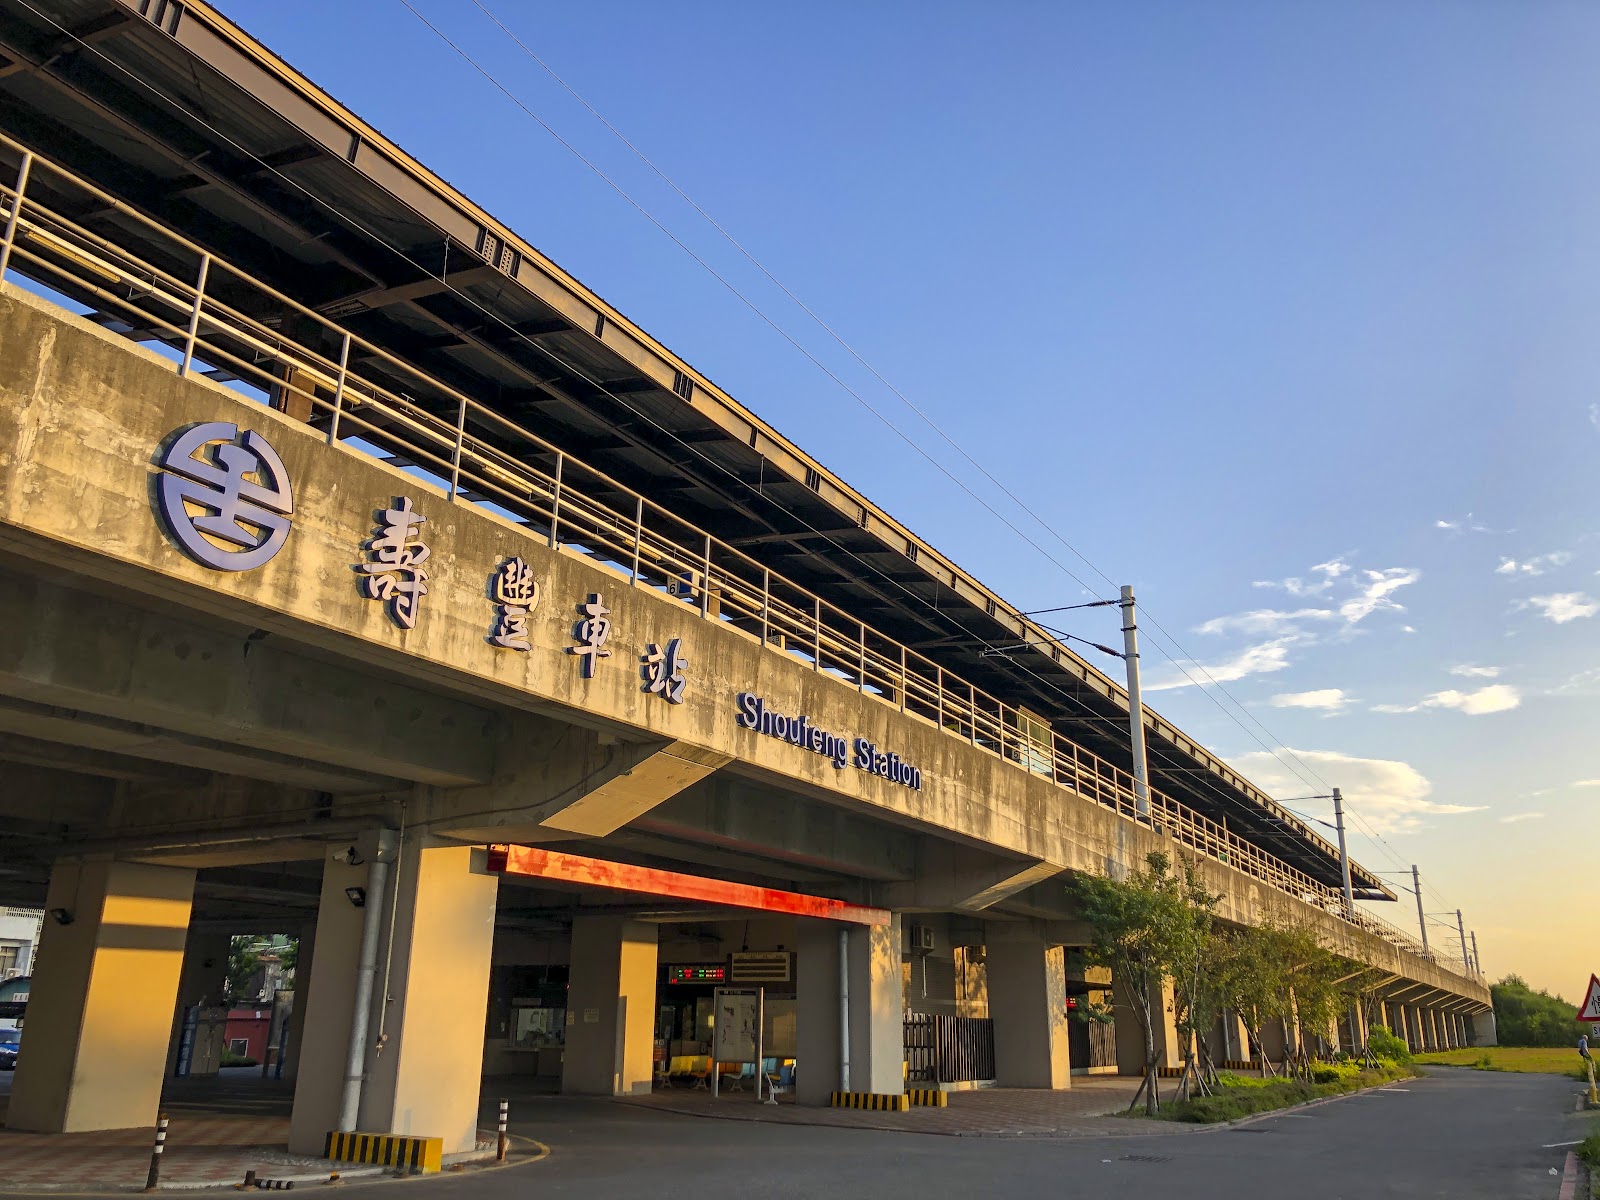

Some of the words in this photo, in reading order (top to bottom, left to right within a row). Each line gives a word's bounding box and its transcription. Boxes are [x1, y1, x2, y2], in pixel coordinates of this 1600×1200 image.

[353, 496, 688, 705] 壽豐車站
[669, 583, 676, 594] 6
[737, 692, 848, 769] Shoufeng
[854, 737, 922, 791] Station
